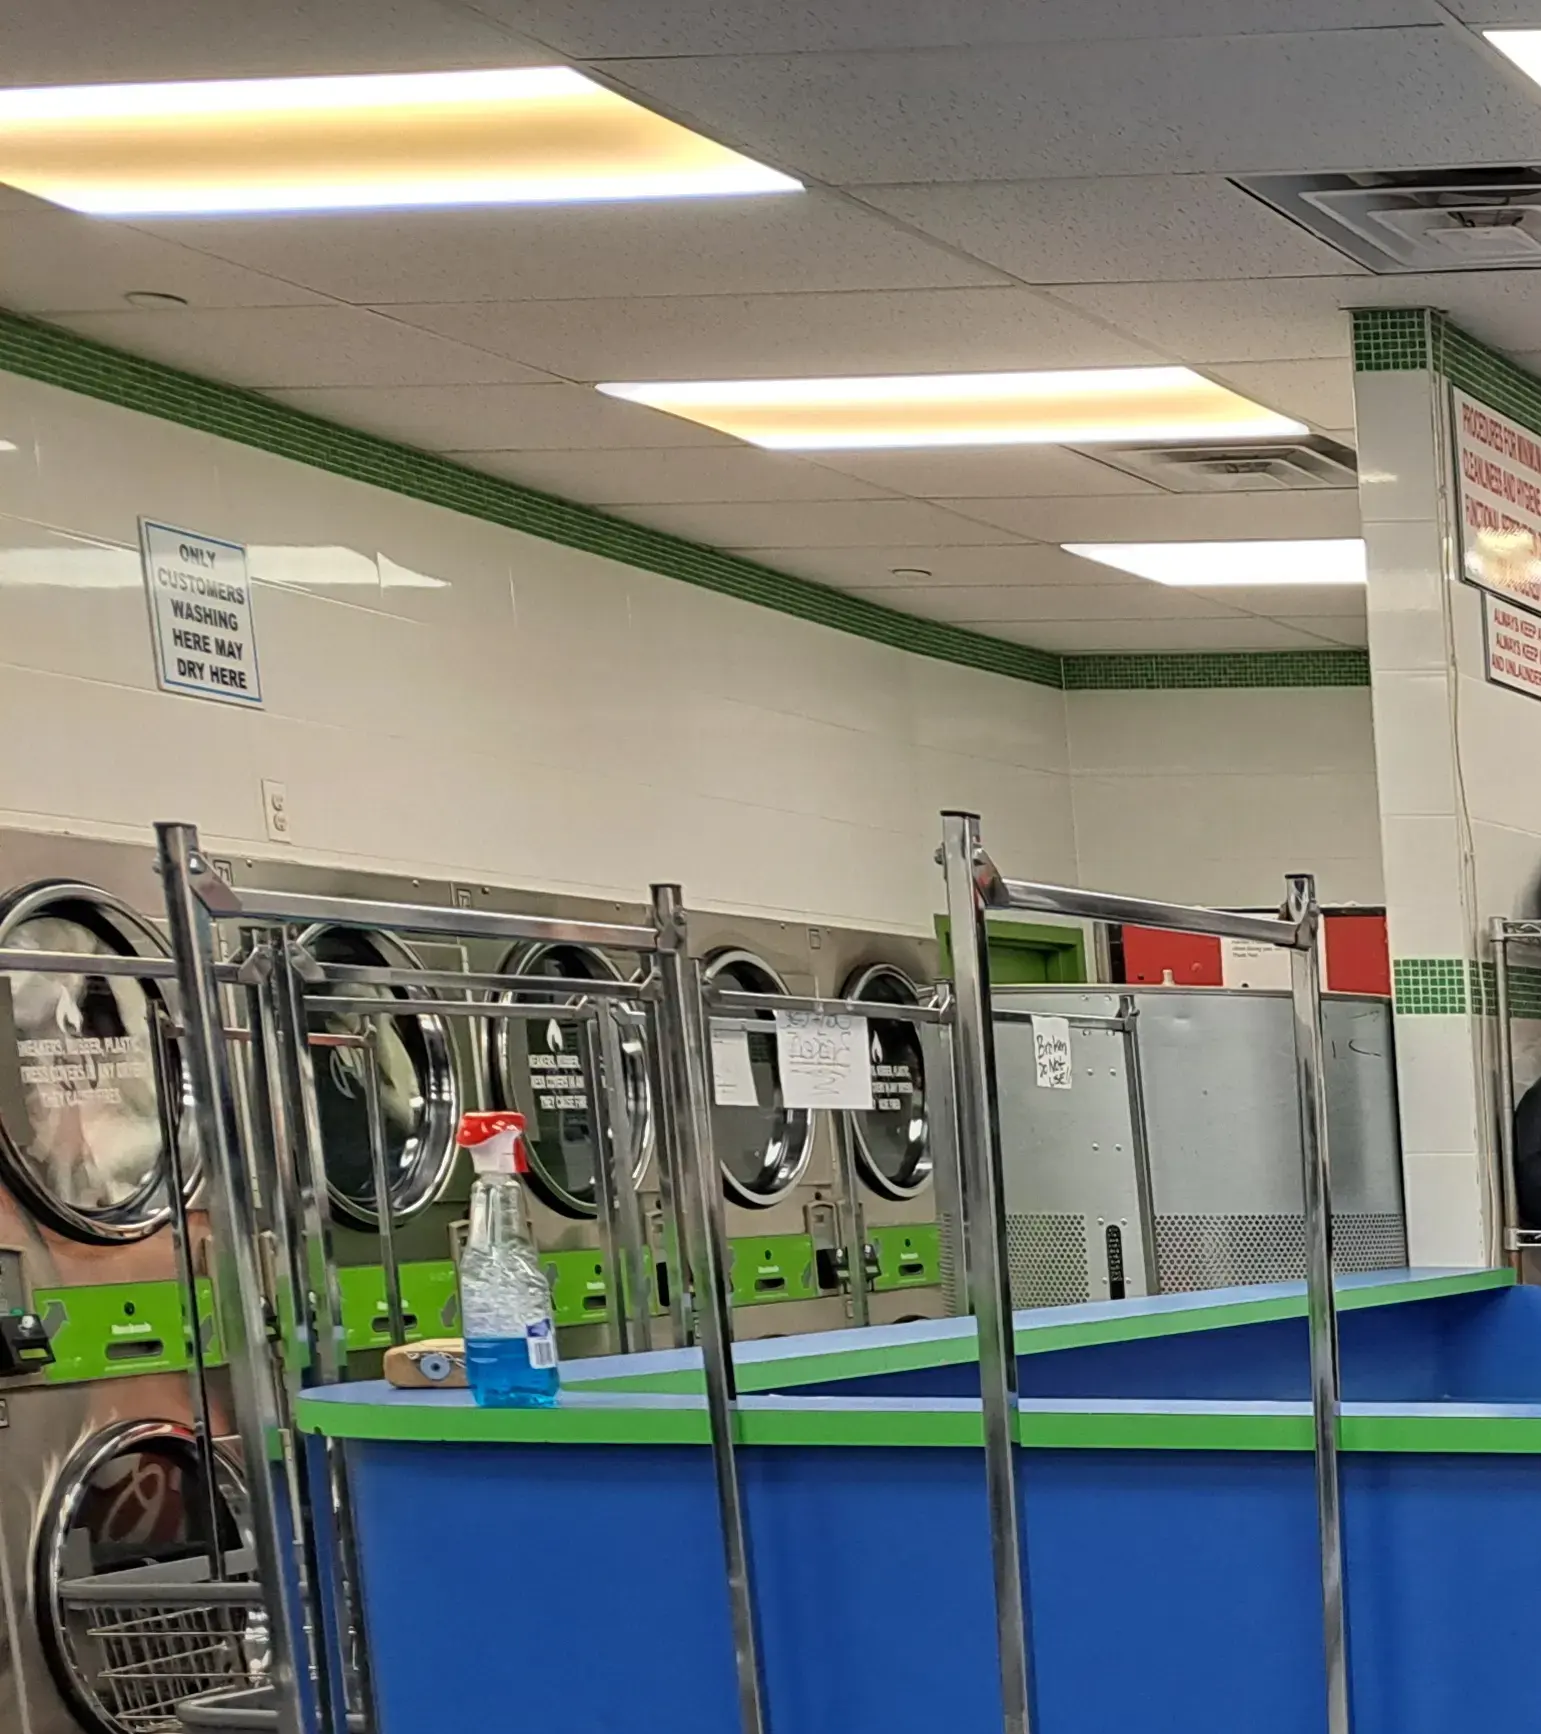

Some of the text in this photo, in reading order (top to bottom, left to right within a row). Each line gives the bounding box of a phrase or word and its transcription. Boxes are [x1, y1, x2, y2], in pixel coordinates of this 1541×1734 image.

[178, 544, 216, 566] ONLY
[157, 568, 245, 604] CUSTOMERS
[170, 599, 238, 631] WASHING
[172, 628, 242, 660] HERE MAY
[177, 658, 247, 689] DRY HERE
